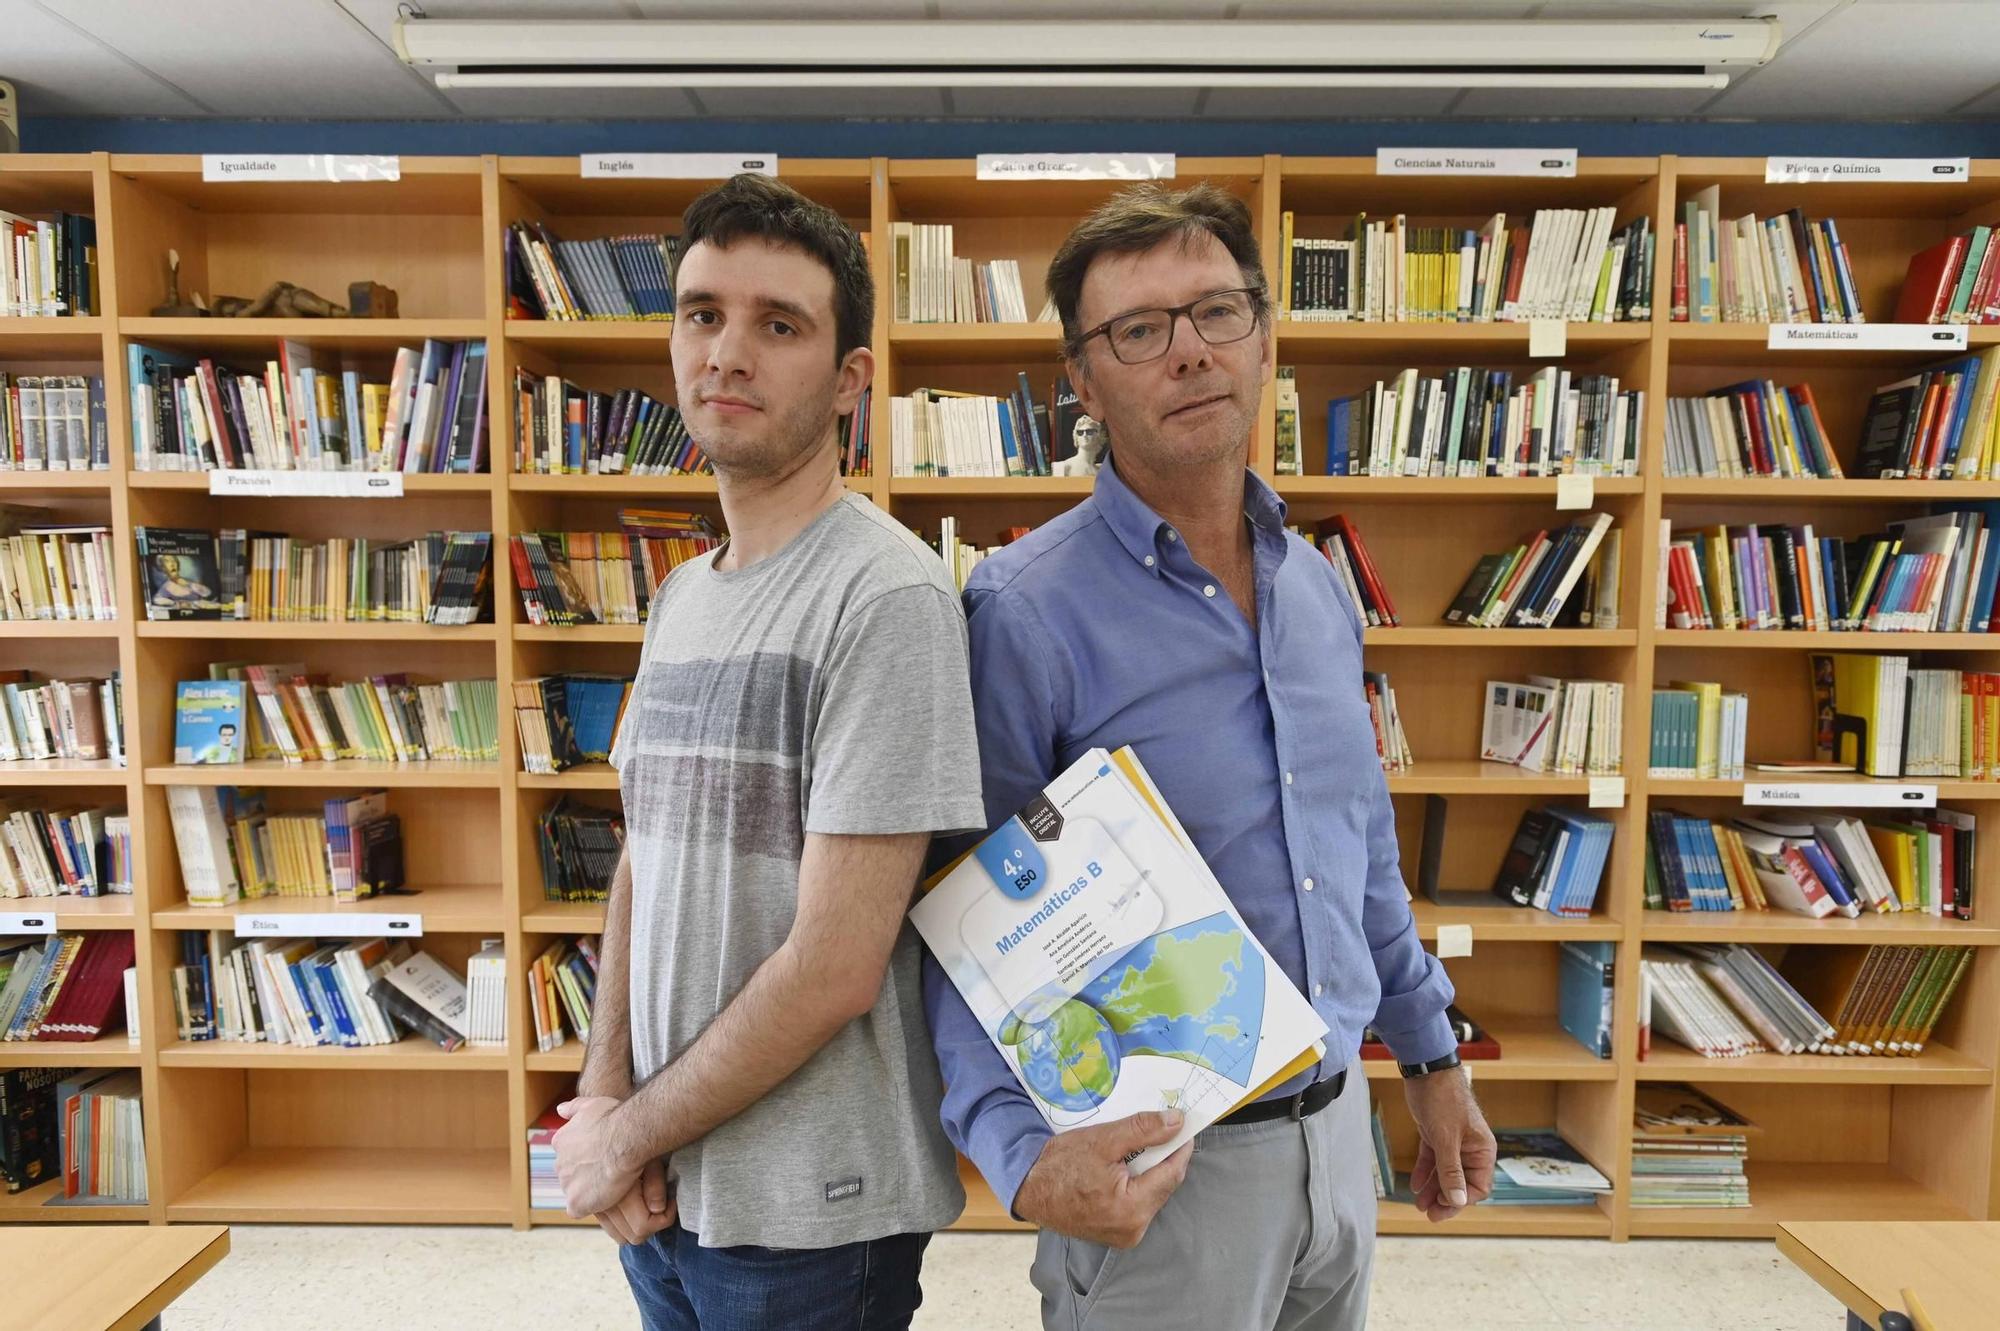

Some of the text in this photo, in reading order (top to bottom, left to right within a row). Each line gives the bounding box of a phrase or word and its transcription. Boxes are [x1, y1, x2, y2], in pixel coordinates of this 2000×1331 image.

[220, 160, 277, 173] Igualdade
[598, 160, 635, 172] Inglés
[1394, 157, 1496, 169] Ciencias Naturais
[1822, 165, 1830, 174] e
[1832, 162, 1882, 176] Química
[1786, 328, 1859, 340] Matemáticas
[227, 475, 272, 487] Francés
[1760, 789, 1801, 800] Música
[1029, 806, 1050, 825] INCLUYE
[1032, 812, 1054, 831] LICENCIA
[1038, 819, 1057, 836] DIGITAL
[1014, 868, 1038, 892] ESO
[995, 860, 1104, 956] Matemáticas B
[251, 917, 280, 930] Ética
